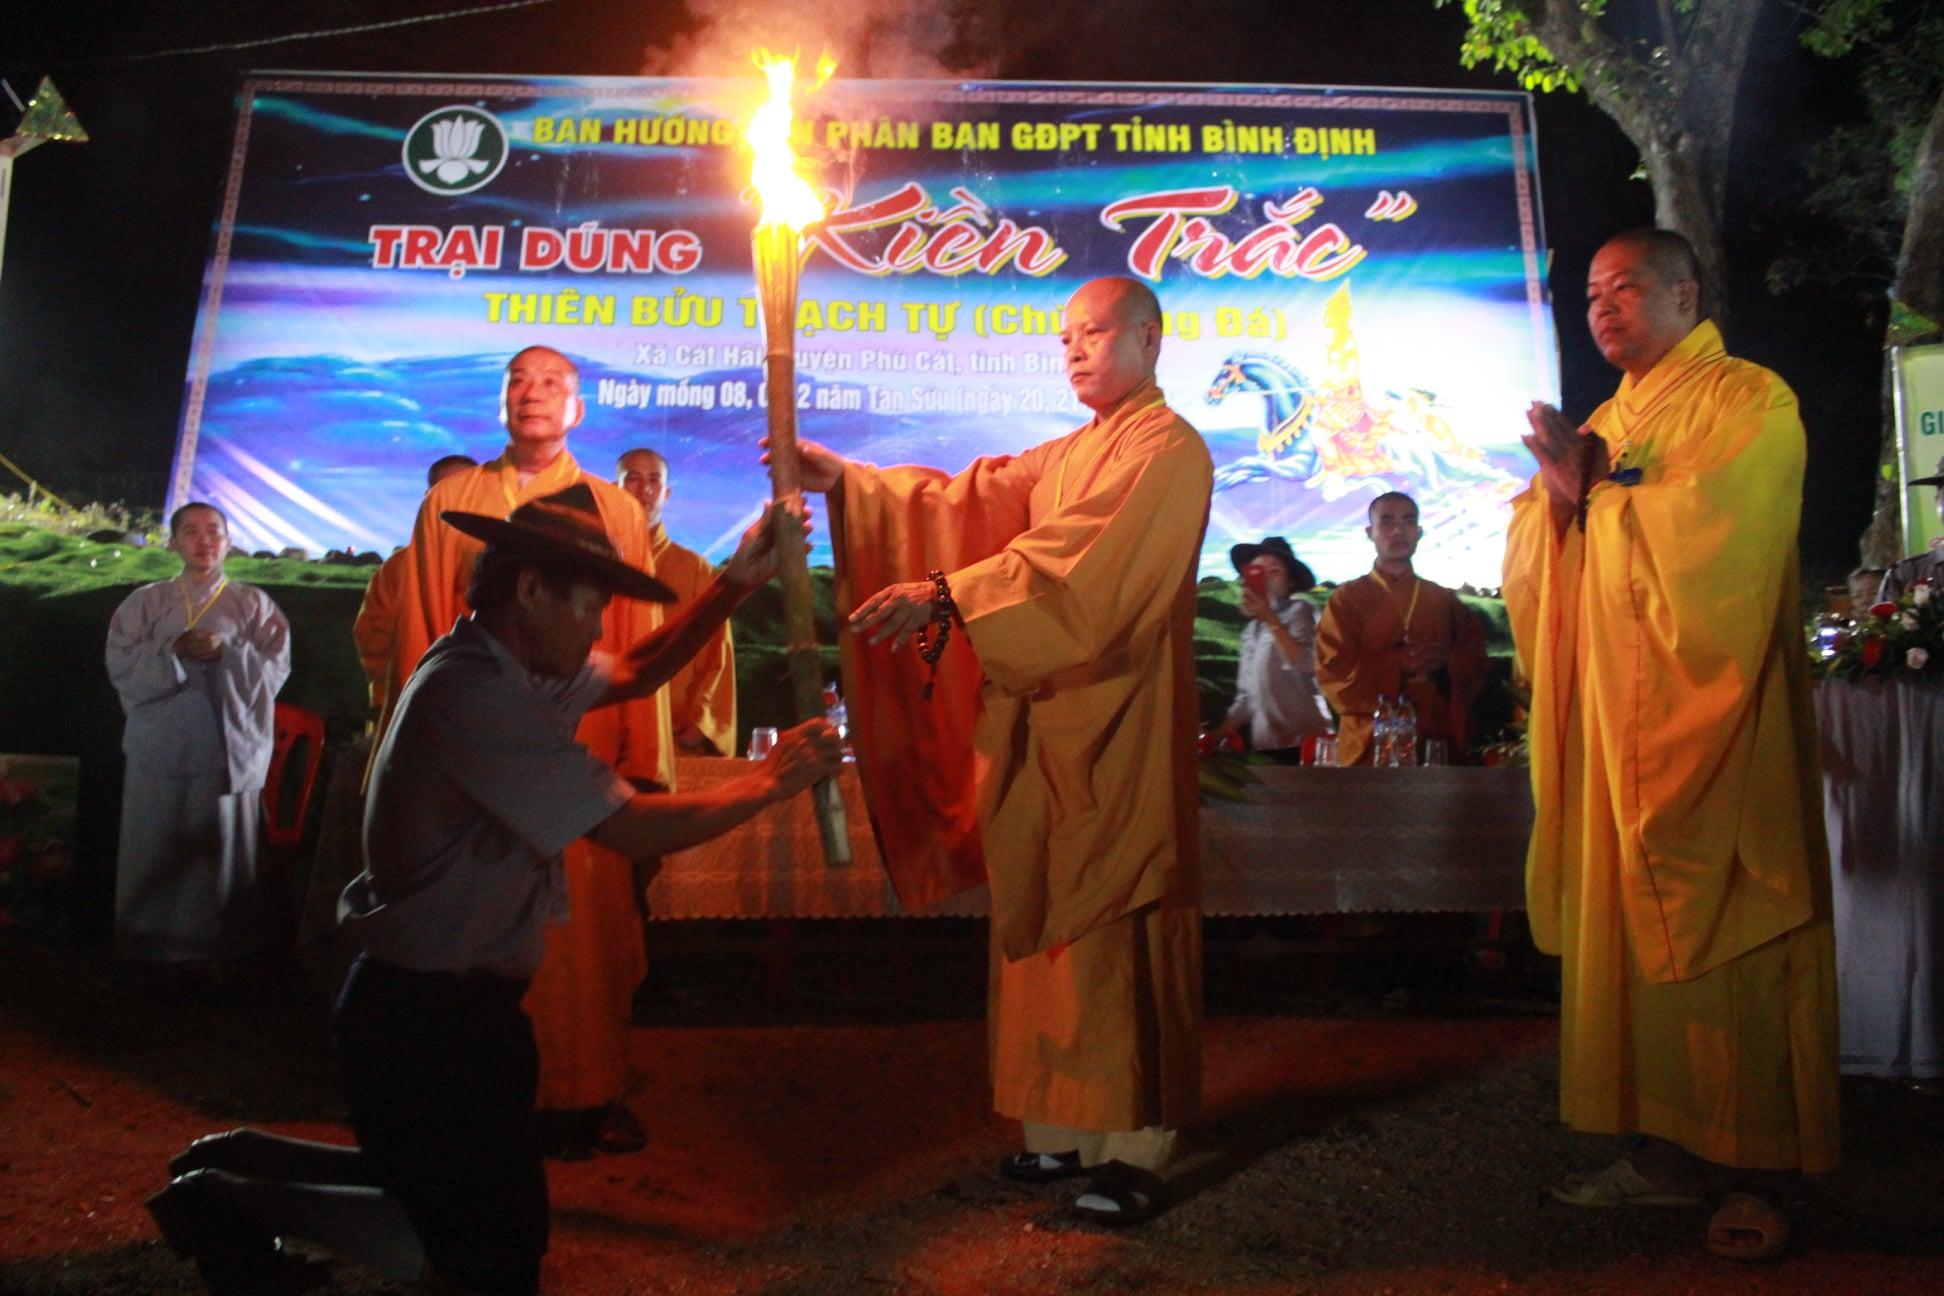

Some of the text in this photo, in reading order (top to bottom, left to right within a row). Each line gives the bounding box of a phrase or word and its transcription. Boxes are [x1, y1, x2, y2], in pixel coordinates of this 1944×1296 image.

[533, 117, 601, 143] BAN
[826, 115, 919, 149] PHÂN
[931, 122, 1000, 150] BAN
[1012, 122, 1101, 151] GĐPT
[1111, 116, 1191, 152] TỈNH
[1202, 118, 1283, 154] BÌNH
[1294, 127, 1376, 160] ĐỊNH
[369, 225, 504, 278] TRẠI
[484, 287, 615, 324] THIÊN
[631, 286, 724, 328] BỬU
[738, 297, 887, 338] TẠCH
[903, 302, 961, 341] TỰ
[794, 345, 852, 374] uyện
[598, 378, 652, 409] Ngày
